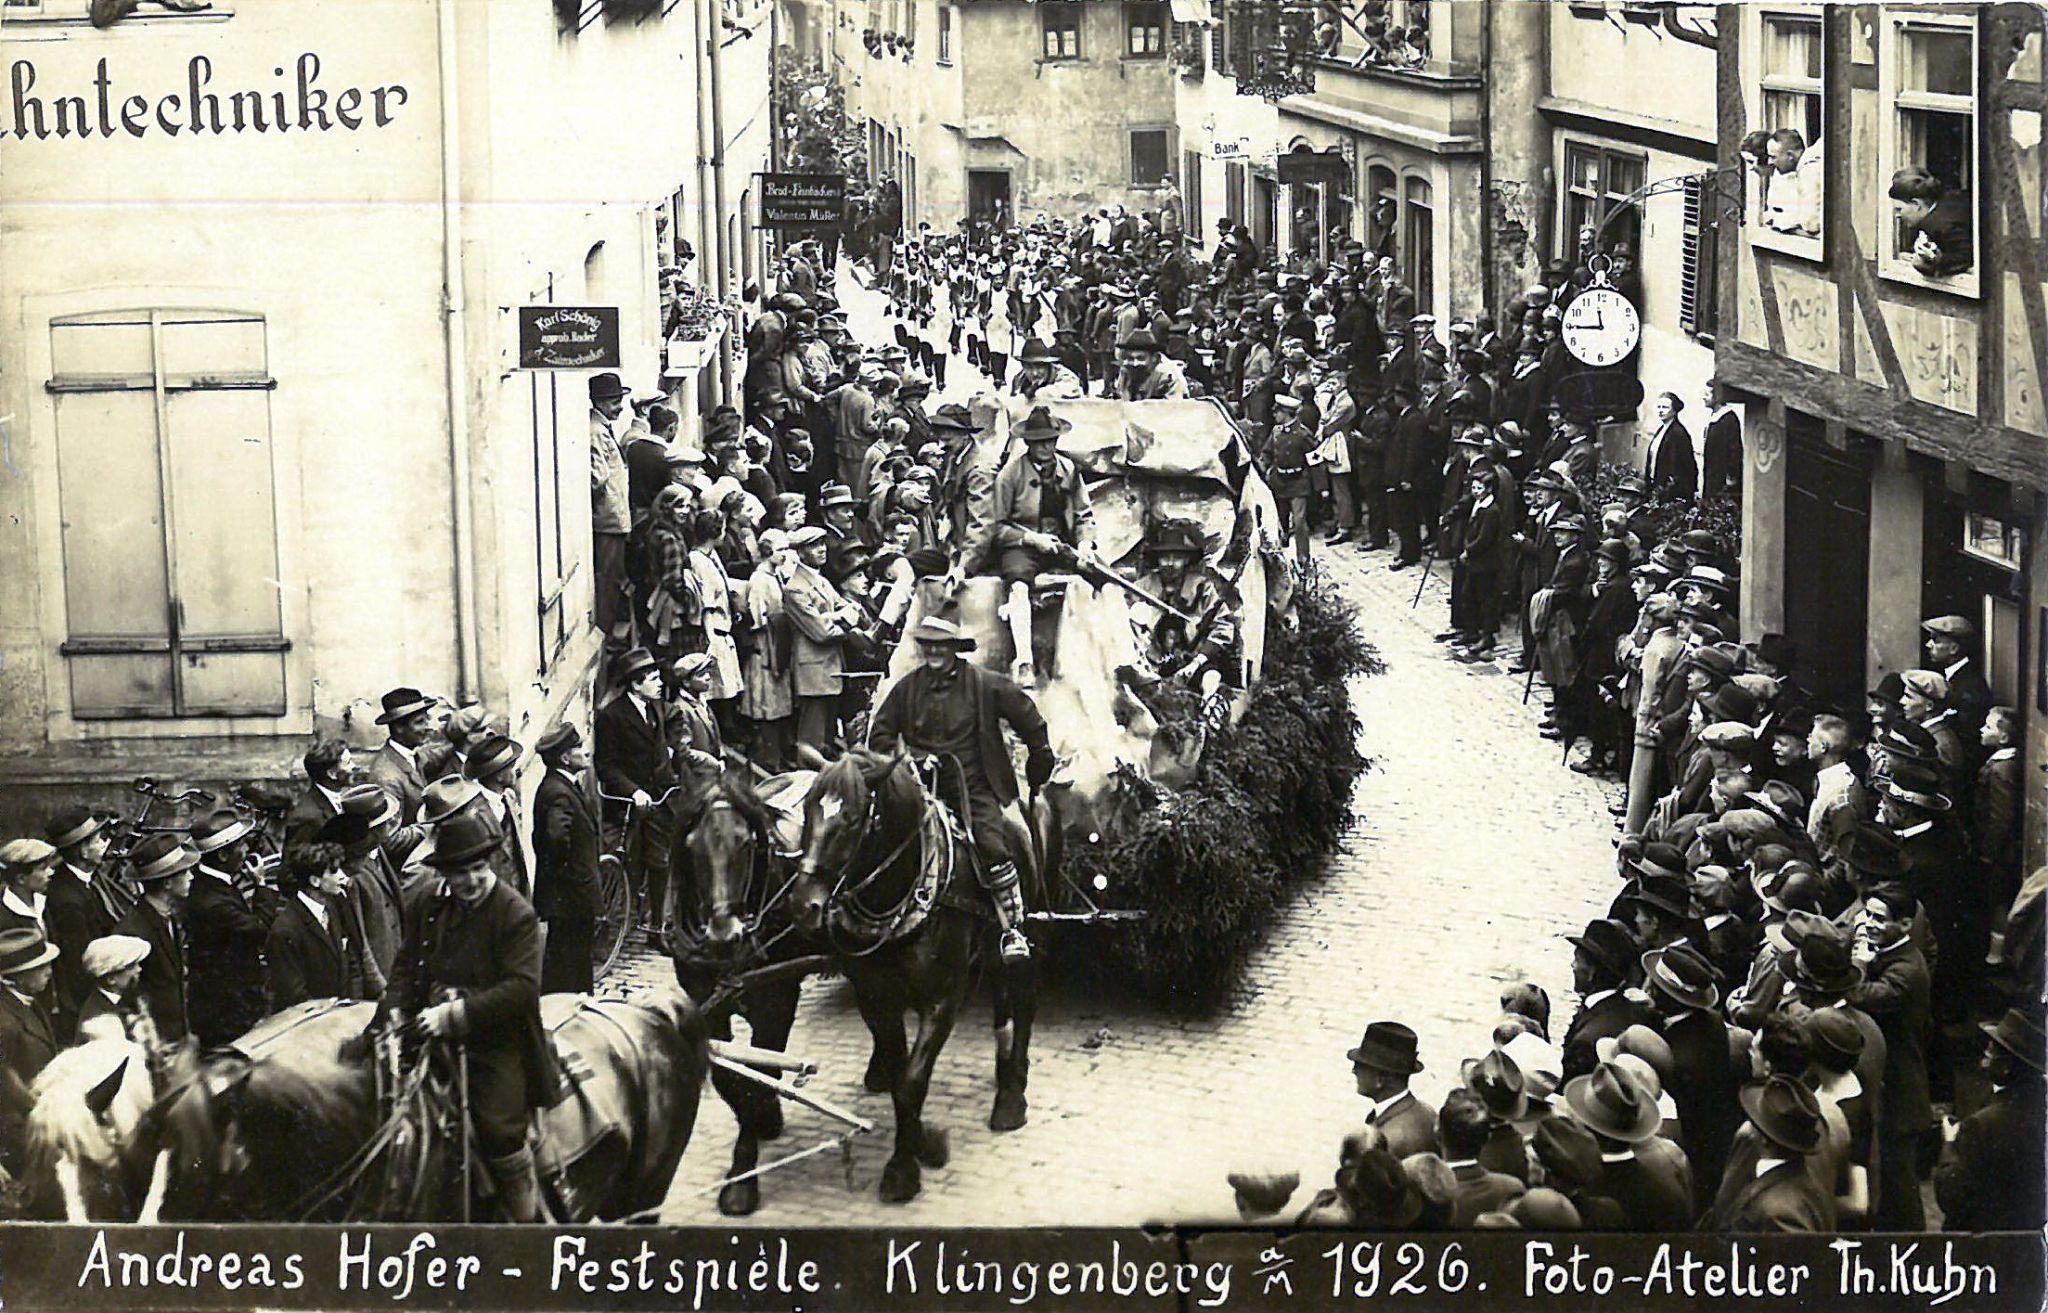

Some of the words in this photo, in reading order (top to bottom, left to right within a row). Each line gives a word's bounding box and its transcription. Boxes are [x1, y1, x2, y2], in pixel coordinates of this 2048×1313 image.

[0, 53, 408, 140] hntechniker
[1214, 142, 1240, 155] Bank
[534, 311, 560, 331] Karl
